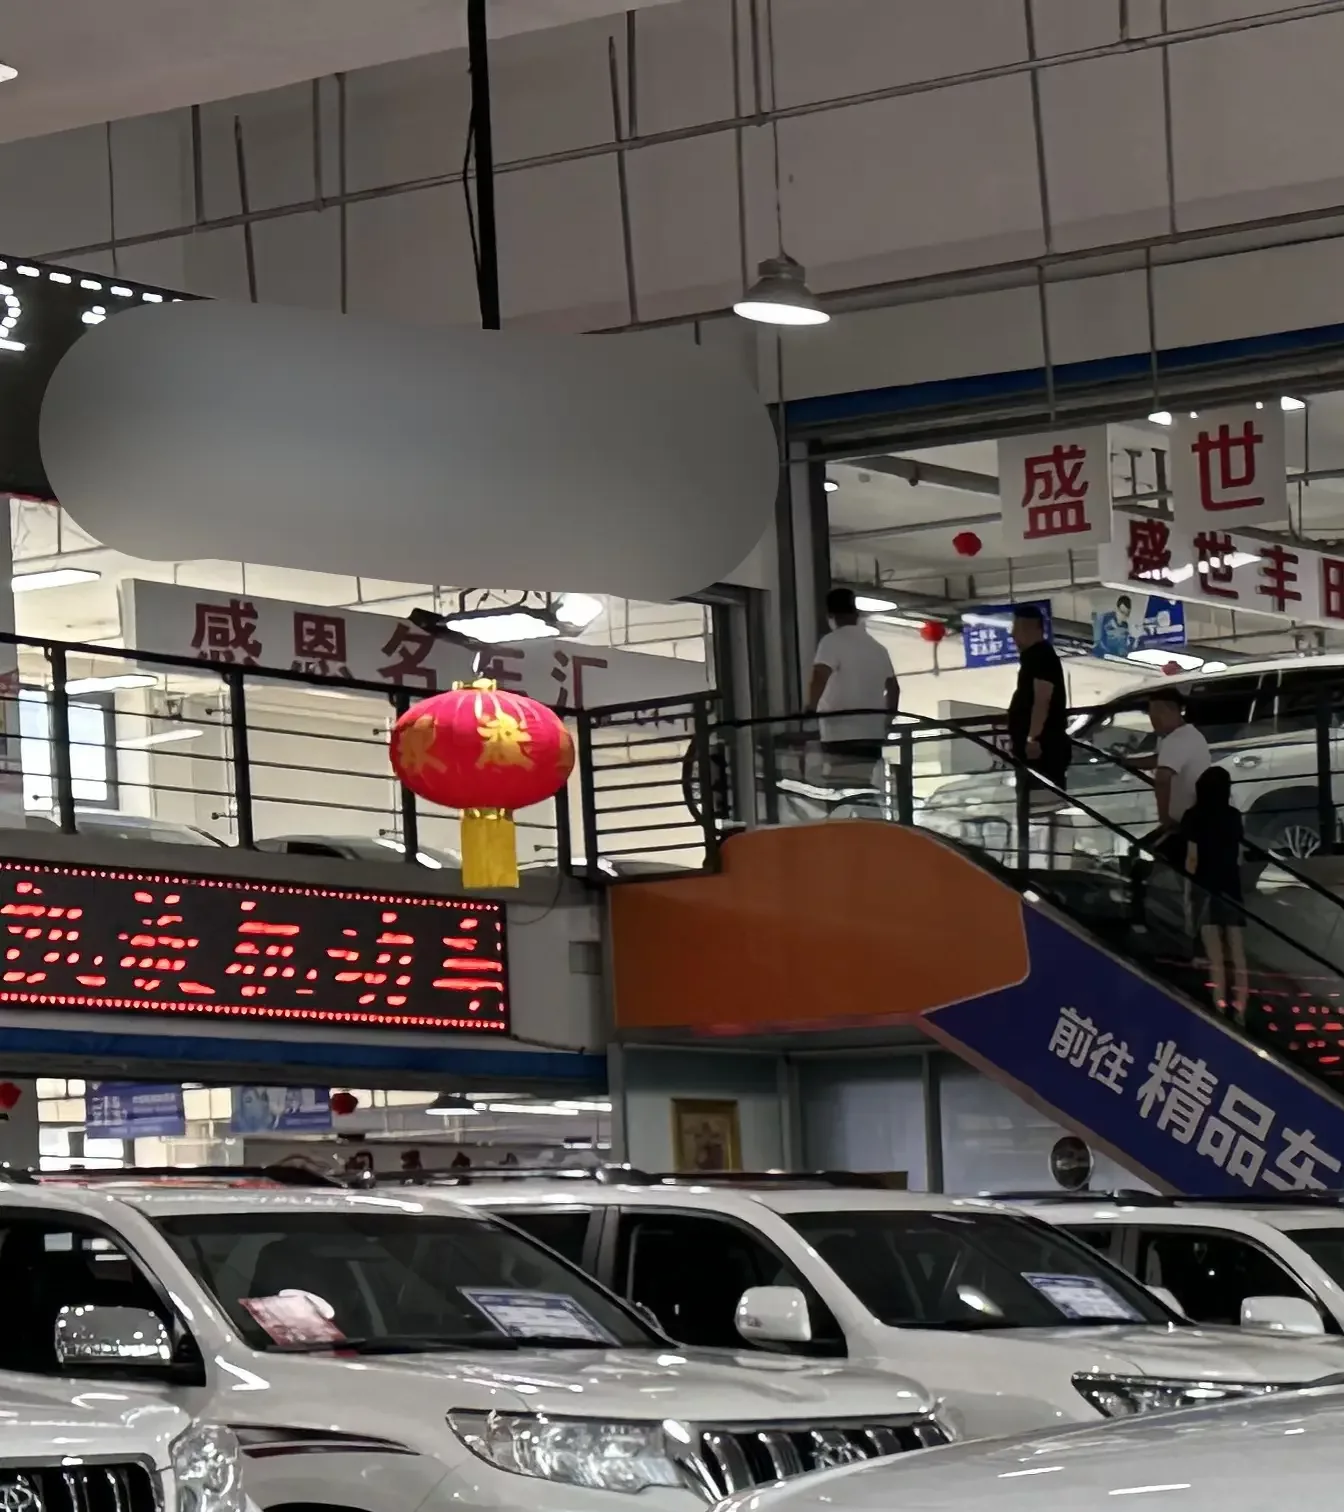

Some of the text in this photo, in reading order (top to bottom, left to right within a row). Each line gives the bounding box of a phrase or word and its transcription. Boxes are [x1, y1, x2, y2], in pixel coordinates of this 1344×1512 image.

[1022, 444, 1091, 540] 盛
[1191, 421, 1263, 512] 世
[1047, 1006, 1136, 1095] 前往
